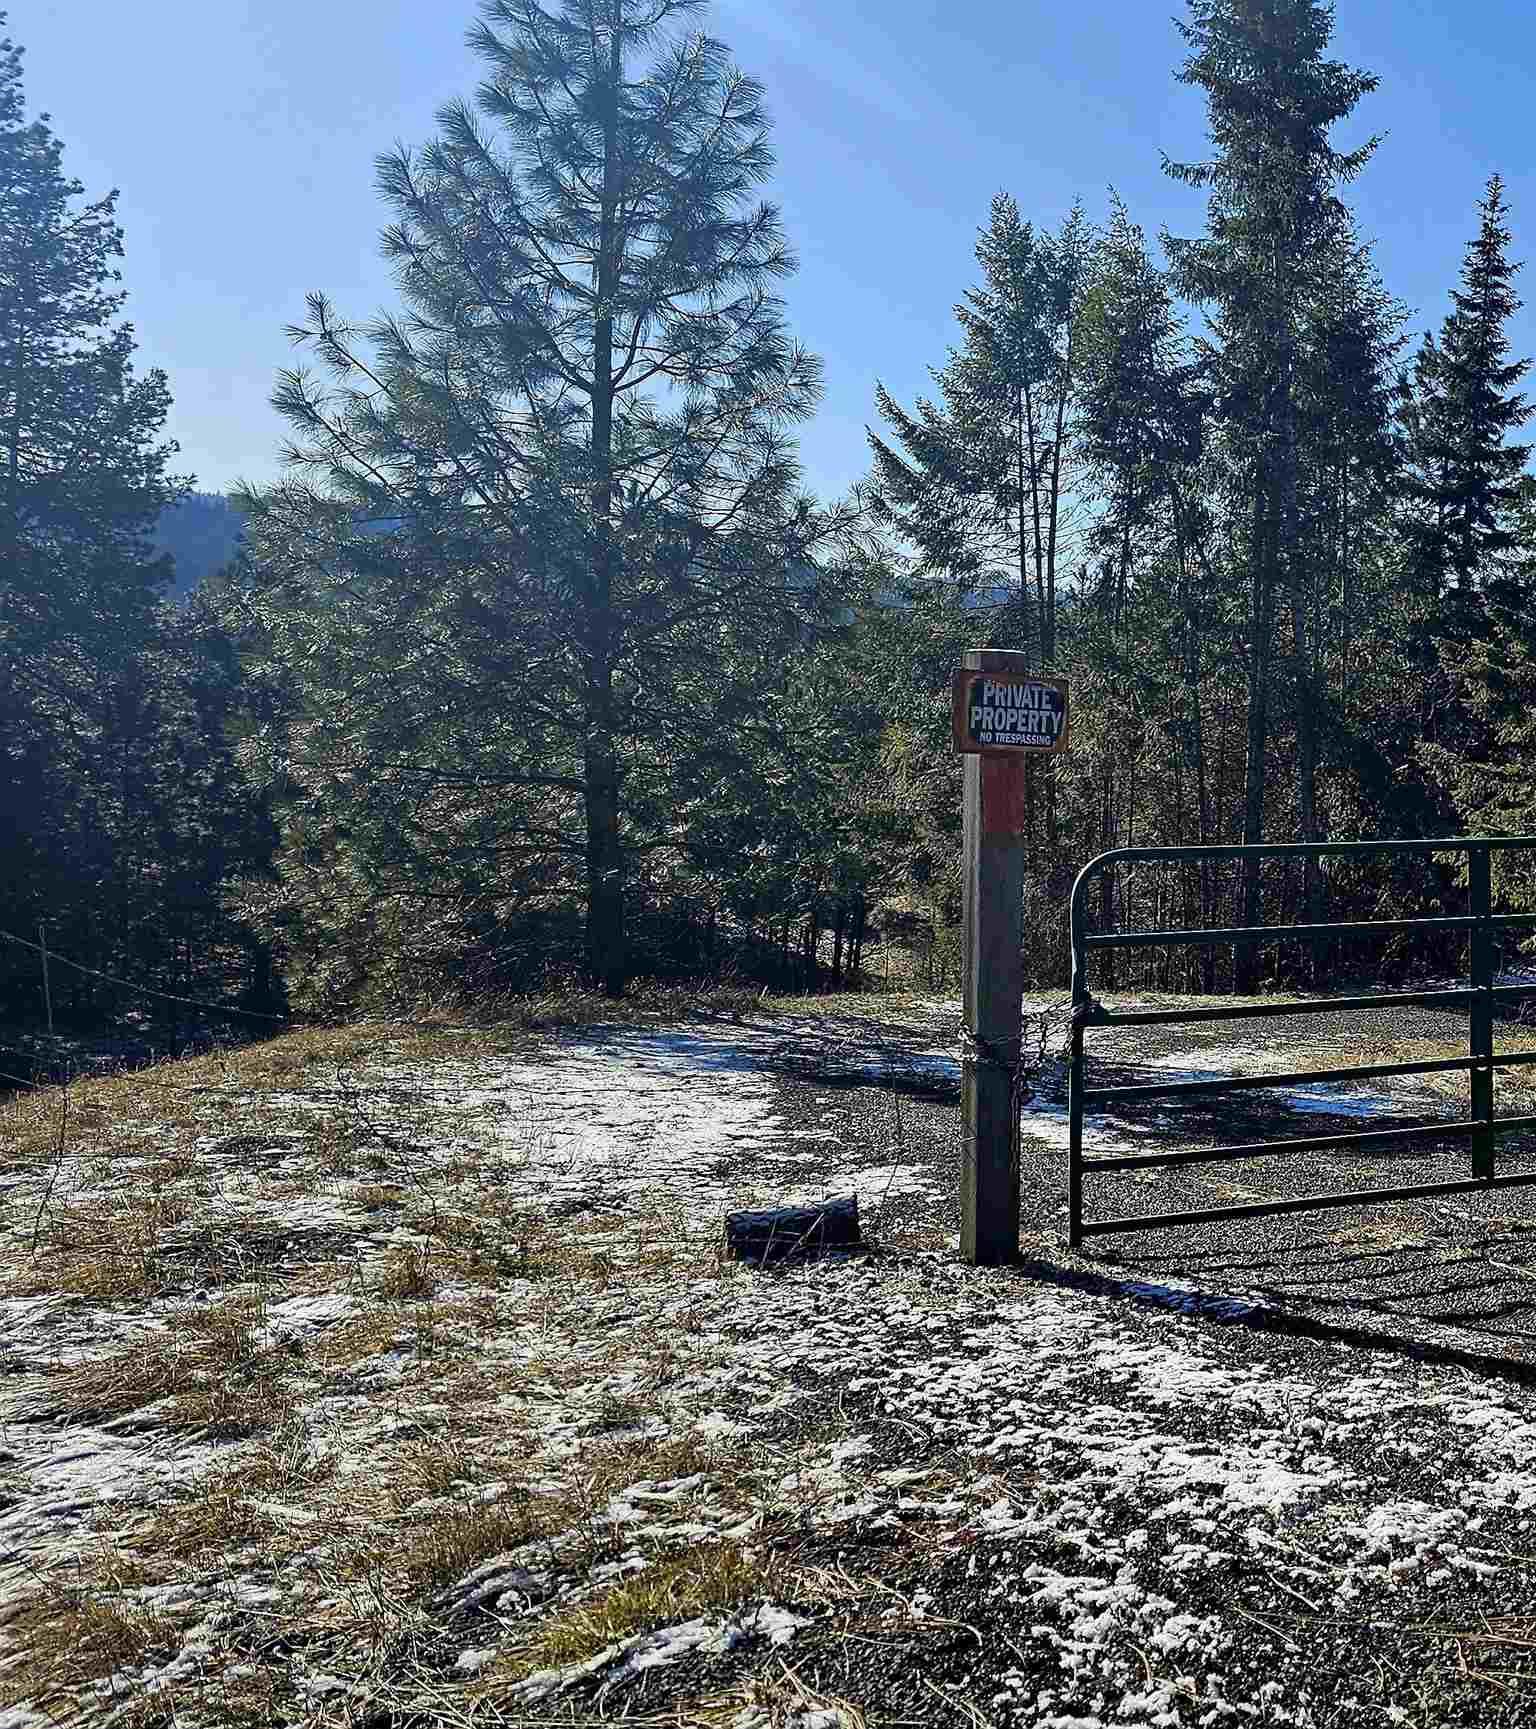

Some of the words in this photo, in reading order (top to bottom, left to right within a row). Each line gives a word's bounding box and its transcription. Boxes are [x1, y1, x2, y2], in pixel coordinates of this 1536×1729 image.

[983, 680, 1057, 710] PRIVATE
[970, 706, 1062, 734] PROPERTY
[980, 732, 992, 743] NO
[995, 733, 1052, 746] TRESPASSING
